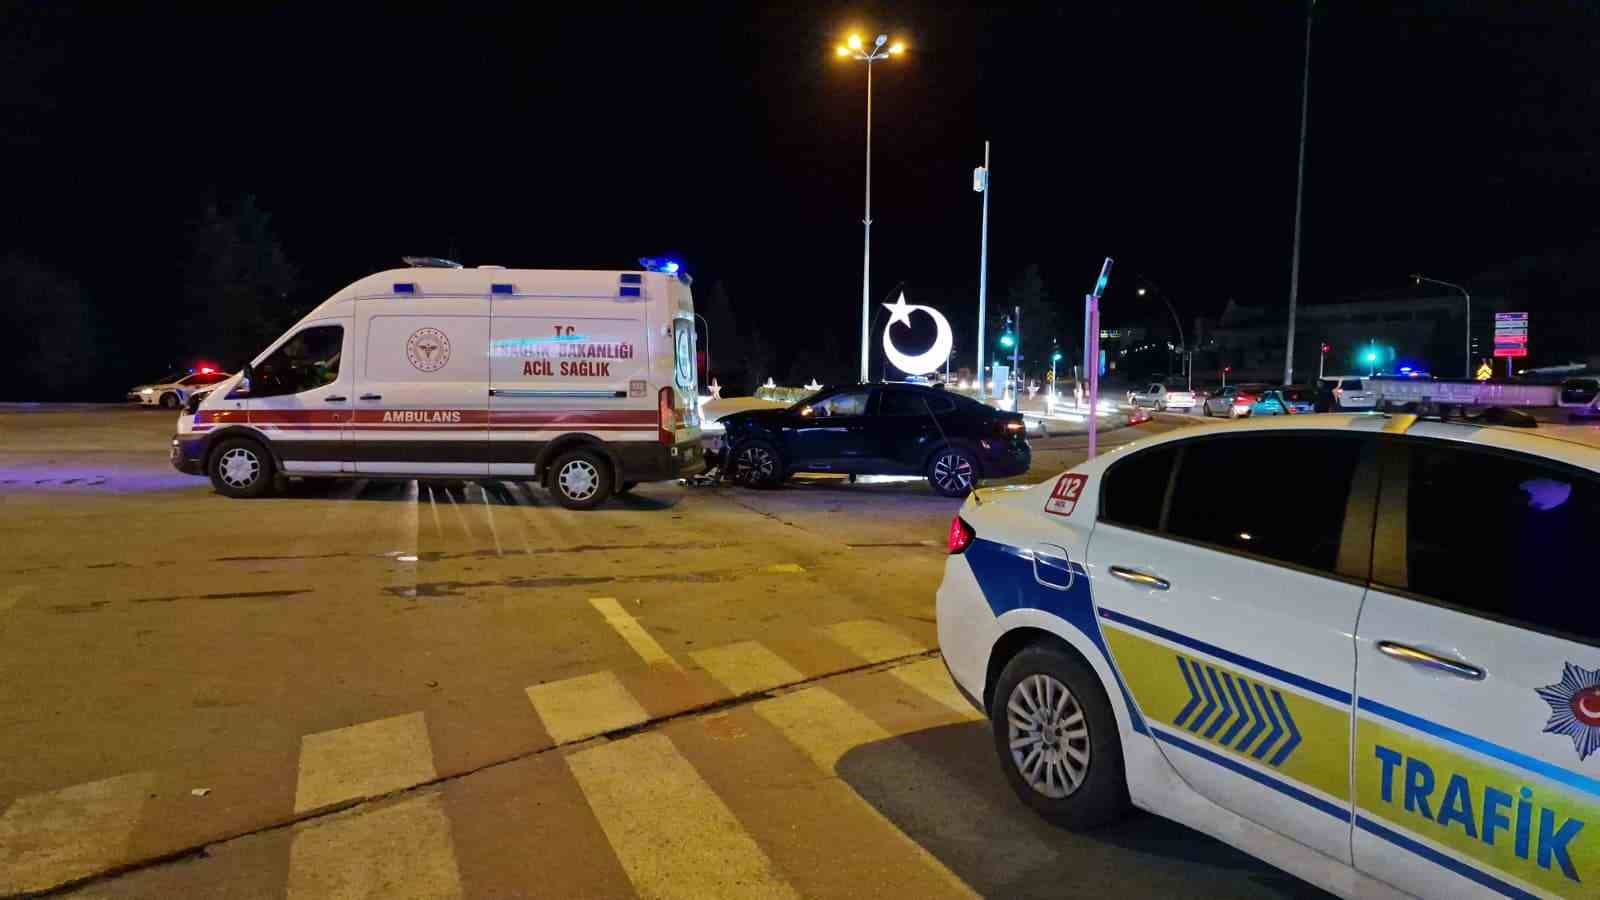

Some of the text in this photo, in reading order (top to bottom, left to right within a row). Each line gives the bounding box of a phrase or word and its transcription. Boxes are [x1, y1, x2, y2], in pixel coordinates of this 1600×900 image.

[523, 358, 610, 377] ACİL SAĞLIK
[383, 410, 461, 423] AMBULANS
[1057, 477, 1081, 497] 112
[1375, 744, 1584, 883] TRAFİK
